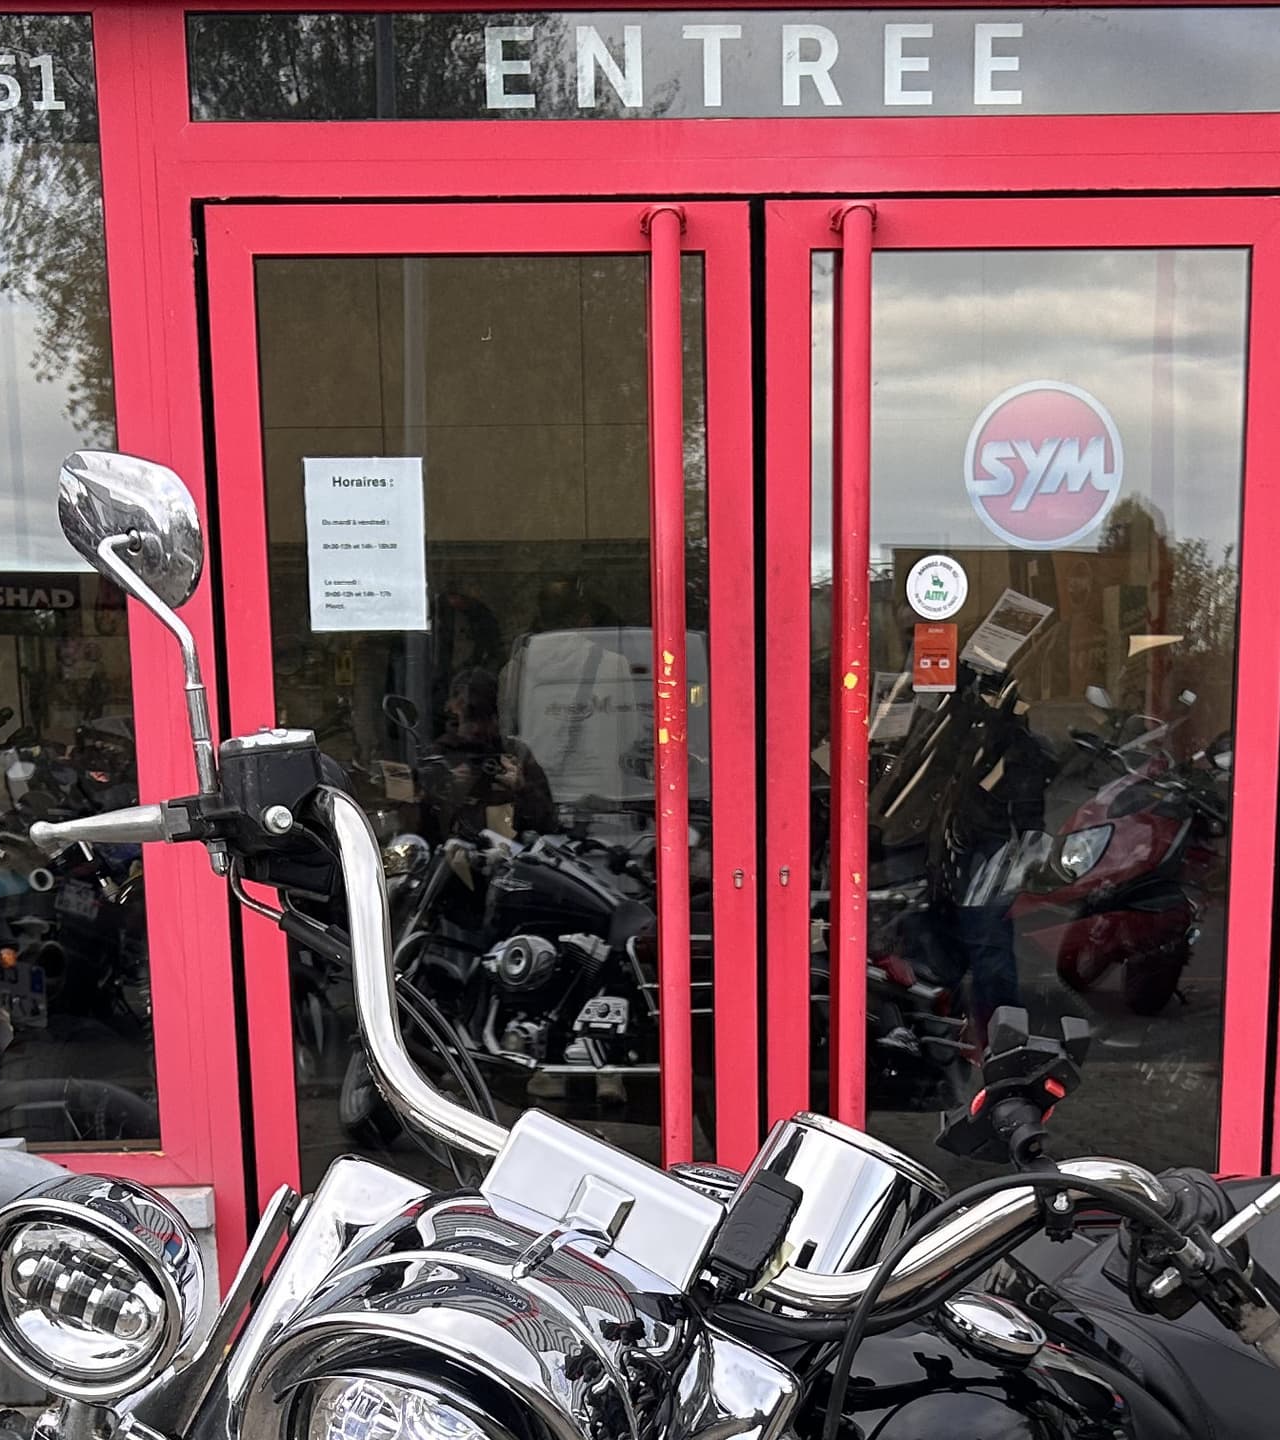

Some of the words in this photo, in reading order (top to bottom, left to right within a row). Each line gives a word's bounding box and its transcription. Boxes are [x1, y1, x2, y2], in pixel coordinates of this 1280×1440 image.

[484, 23, 1024, 110] ENTREE
[332, 475, 387, 488] Horaires
[969, 435, 1119, 513] SYM
